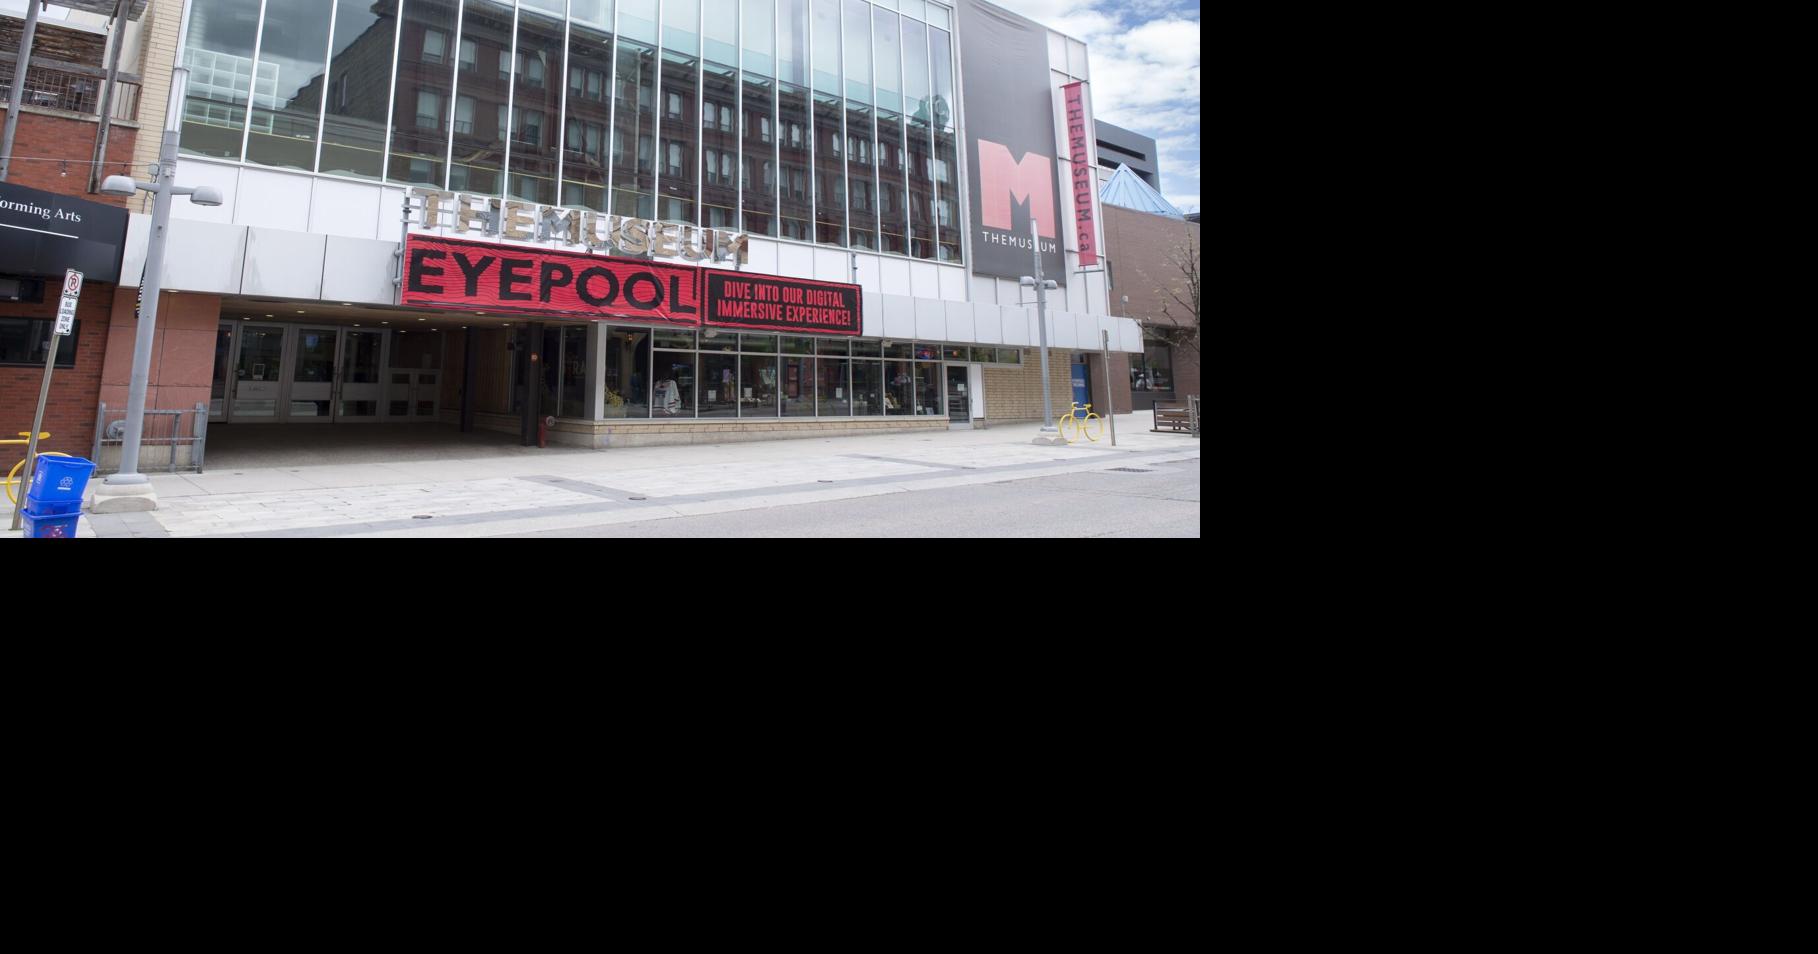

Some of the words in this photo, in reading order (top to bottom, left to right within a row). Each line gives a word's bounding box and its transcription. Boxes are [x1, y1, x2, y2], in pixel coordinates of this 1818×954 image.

[977, 138, 1056, 238] M
[1067, 95, 1091, 252] THEMUSEUM.ca
[0, 197, 51, 220] orming
[54, 208, 82, 222] Arts
[405, 187, 748, 265] THEMUSEUM
[982, 231, 1056, 253] THEMUSUM
[407, 248, 697, 308] EYEPOOL
[724, 281, 752, 300] DIVE
[754, 284, 780, 302] INTO
[782, 287, 804, 304] OUR
[806, 289, 845, 308] DIGITAL
[717, 299, 783, 321] IMMERSIVE
[785, 306, 851, 326] EXPERIENCE!
